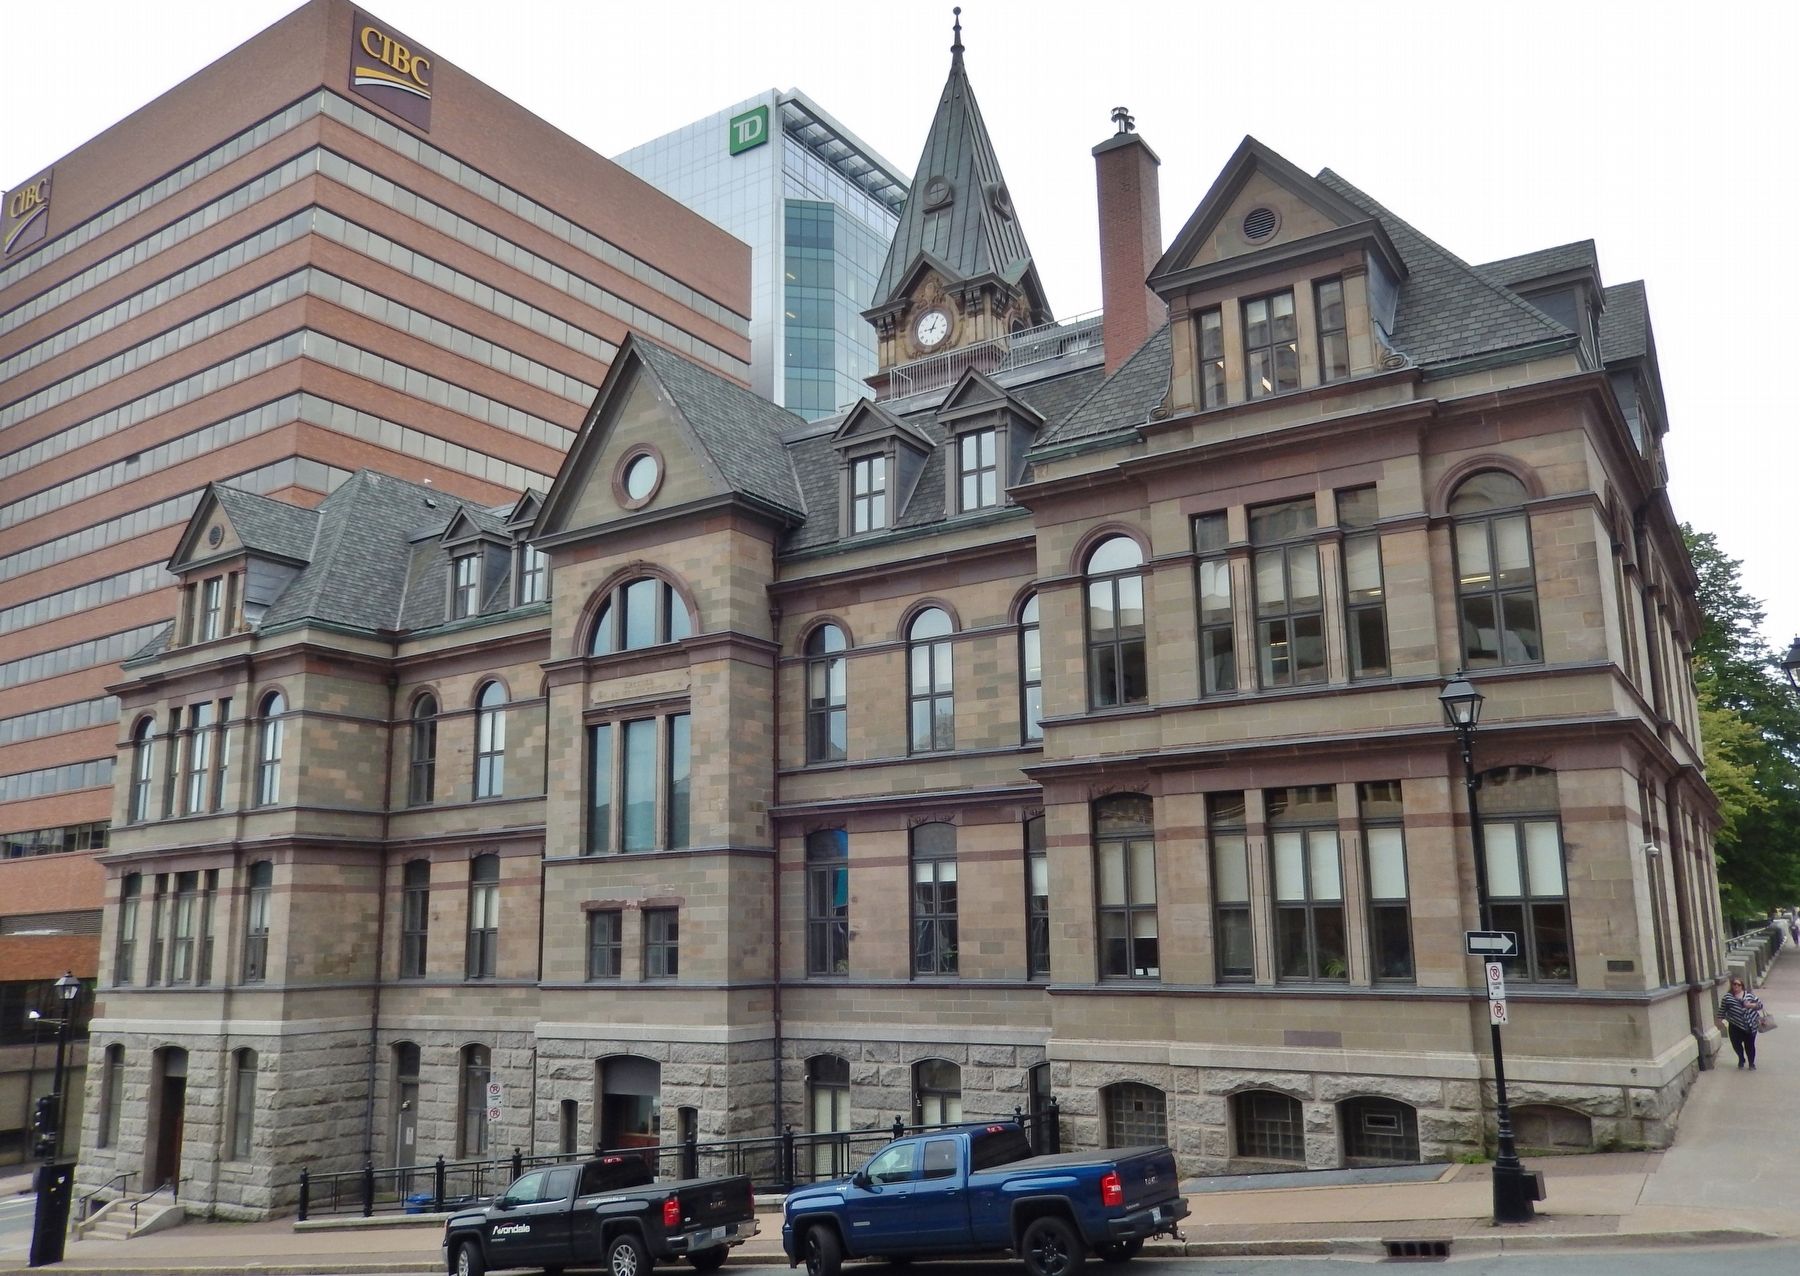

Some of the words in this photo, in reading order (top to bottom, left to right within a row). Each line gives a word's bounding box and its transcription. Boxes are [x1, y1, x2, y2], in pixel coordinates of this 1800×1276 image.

[361, 26, 430, 87] CIBC
[733, 115, 762, 144] TD
[10, 178, 47, 218] CIBC
[492, 1223, 531, 1236] Avondale
